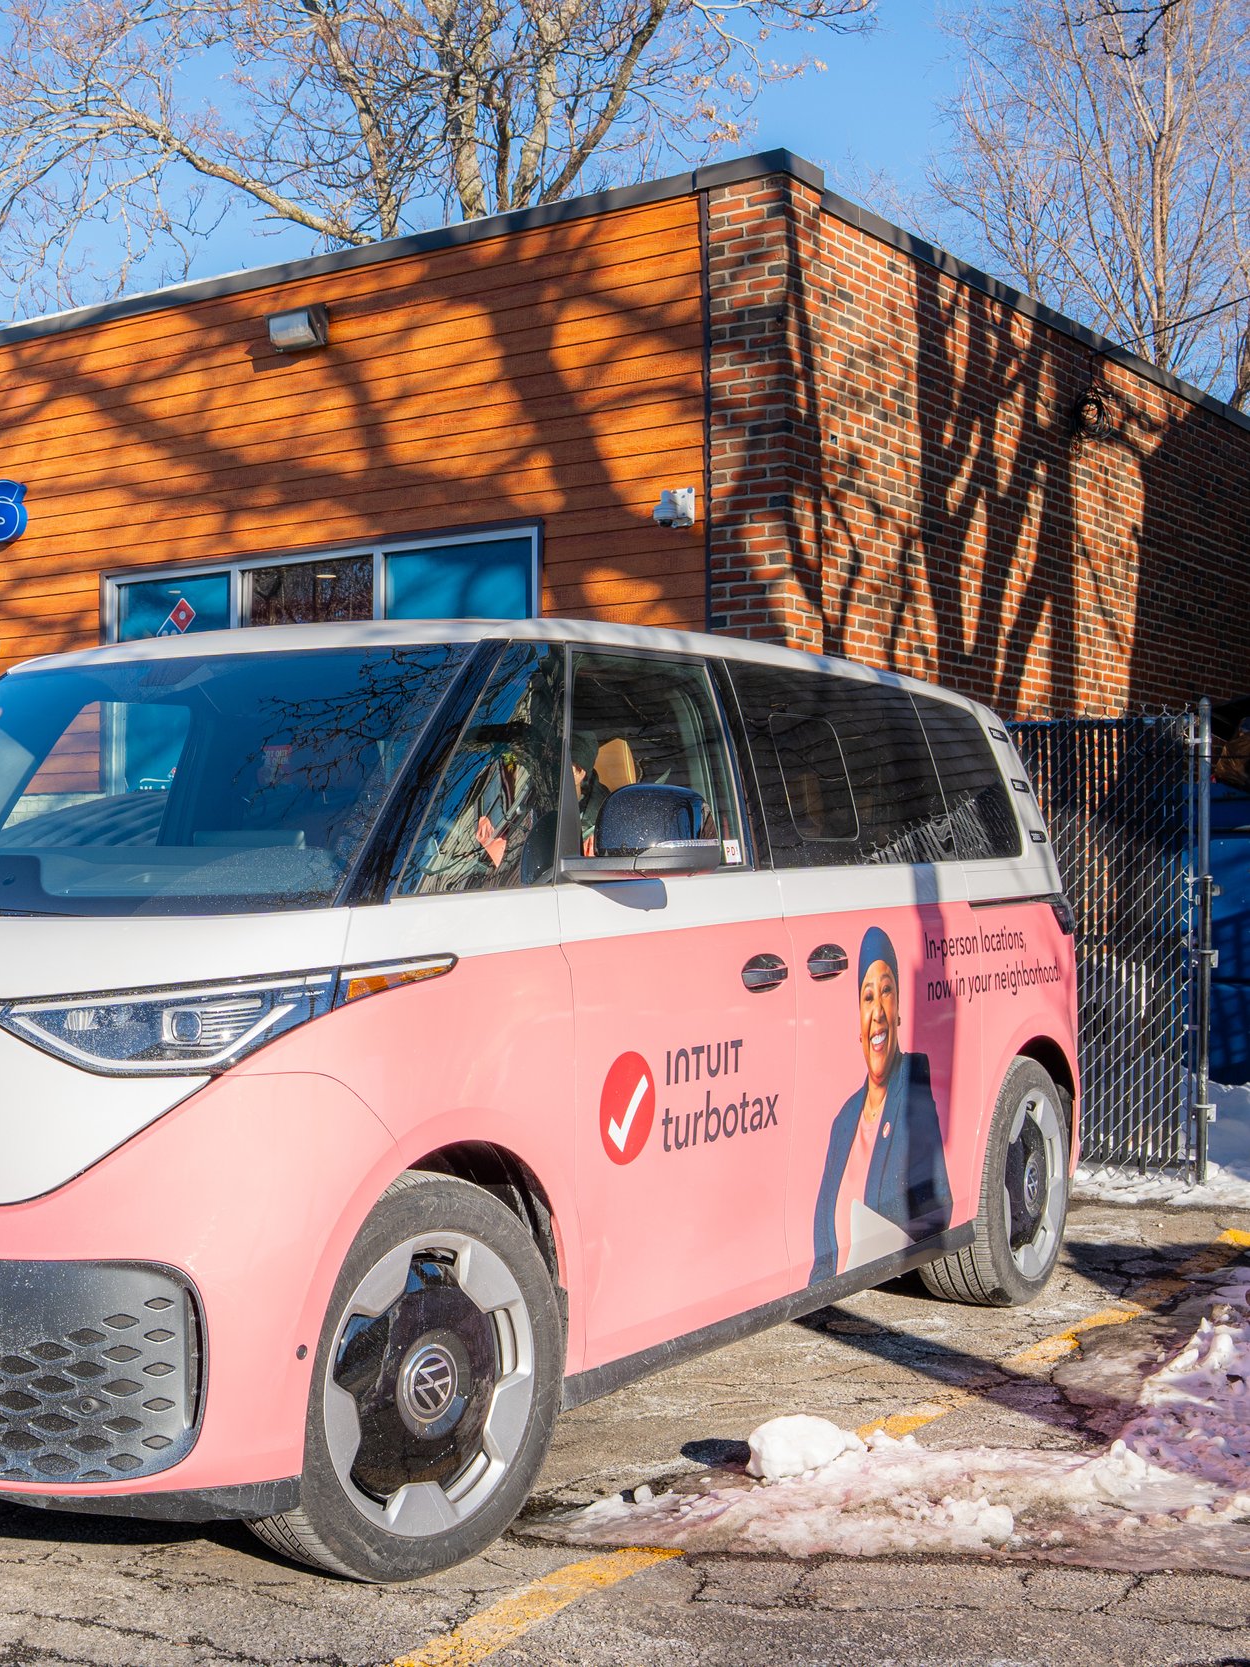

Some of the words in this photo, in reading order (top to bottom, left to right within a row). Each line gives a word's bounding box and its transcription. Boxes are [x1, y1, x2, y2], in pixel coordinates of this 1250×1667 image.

[924, 931, 979, 966] In-person
[979, 925, 1027, 952] locations,
[927, 978, 952, 1001] now
[955, 970, 966, 997] in
[968, 973, 992, 1003] your
[994, 956, 1061, 996] neighborhood.
[666, 1039, 743, 1086] INTUIT
[662, 1090, 779, 1153] turbotax
